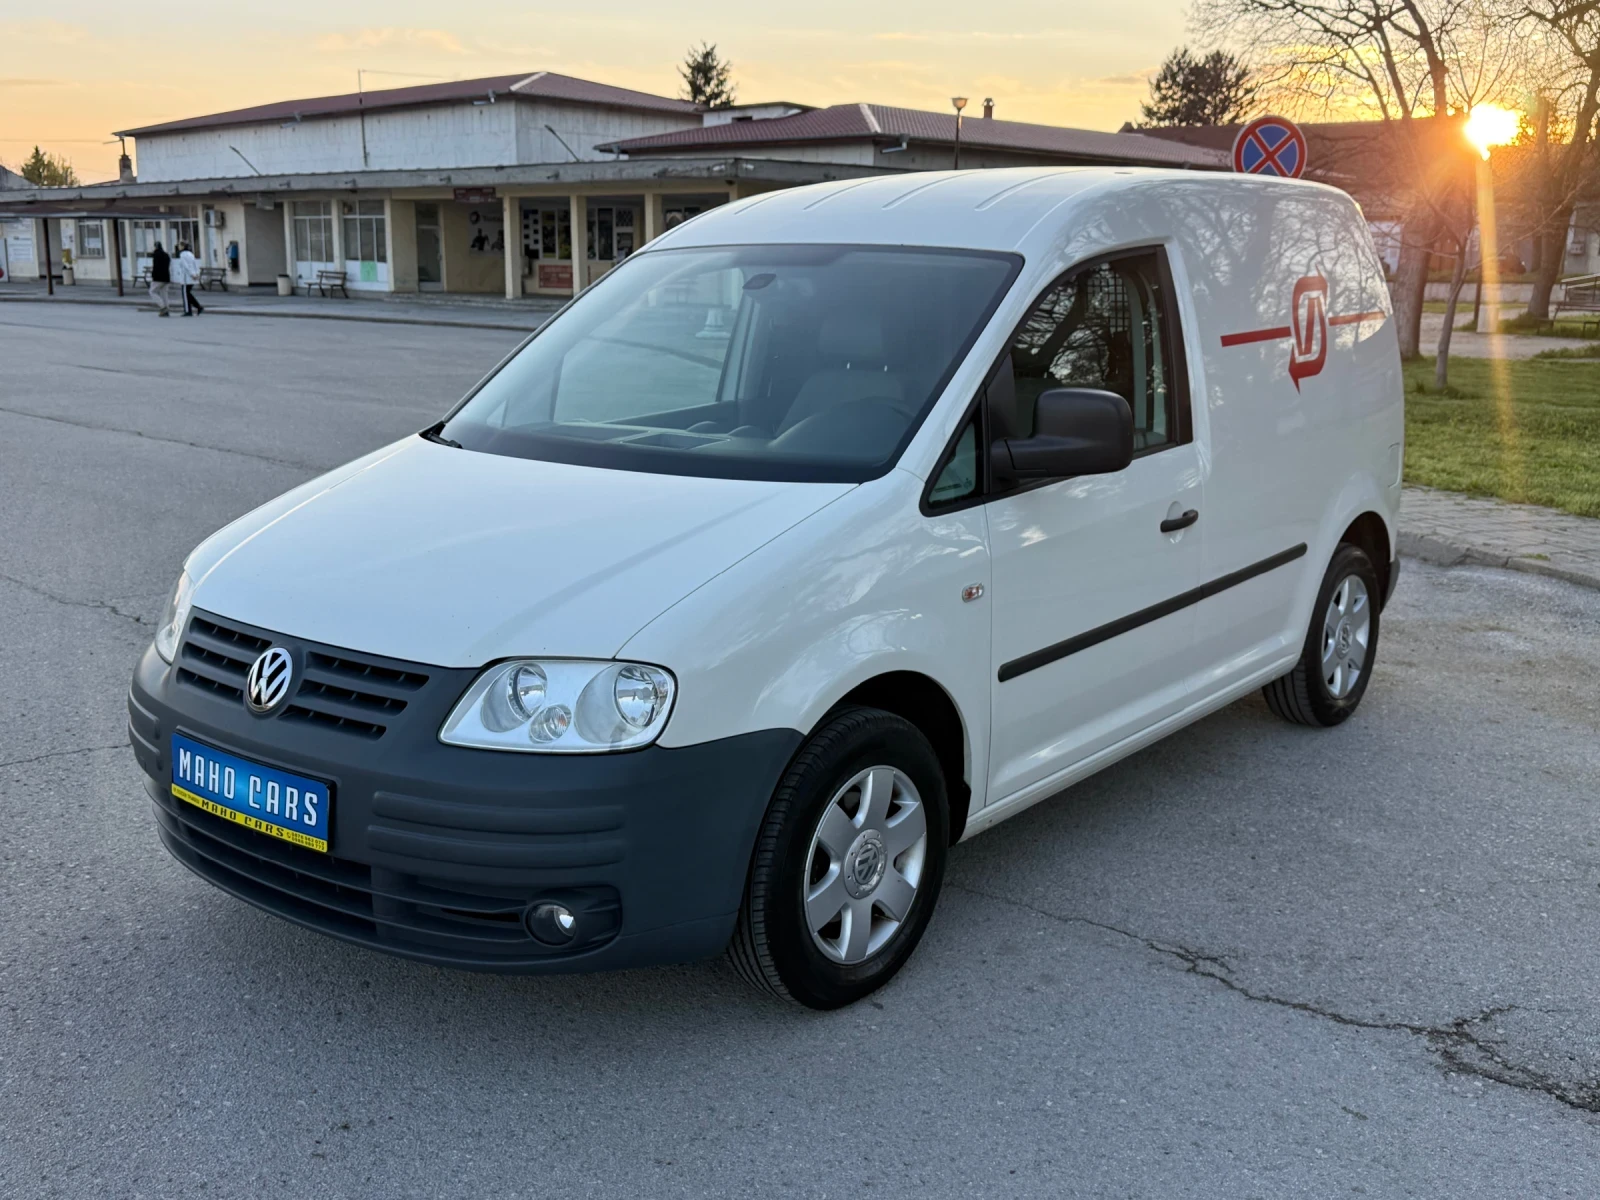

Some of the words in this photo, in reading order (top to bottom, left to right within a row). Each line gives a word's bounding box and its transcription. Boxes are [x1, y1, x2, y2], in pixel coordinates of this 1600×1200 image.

[248, 648, 292, 710] VW
[179, 748, 235, 800] MAHO
[249, 775, 318, 827] CARS
[201, 799, 237, 821] MAHO
[244, 816, 284, 837] CARS
